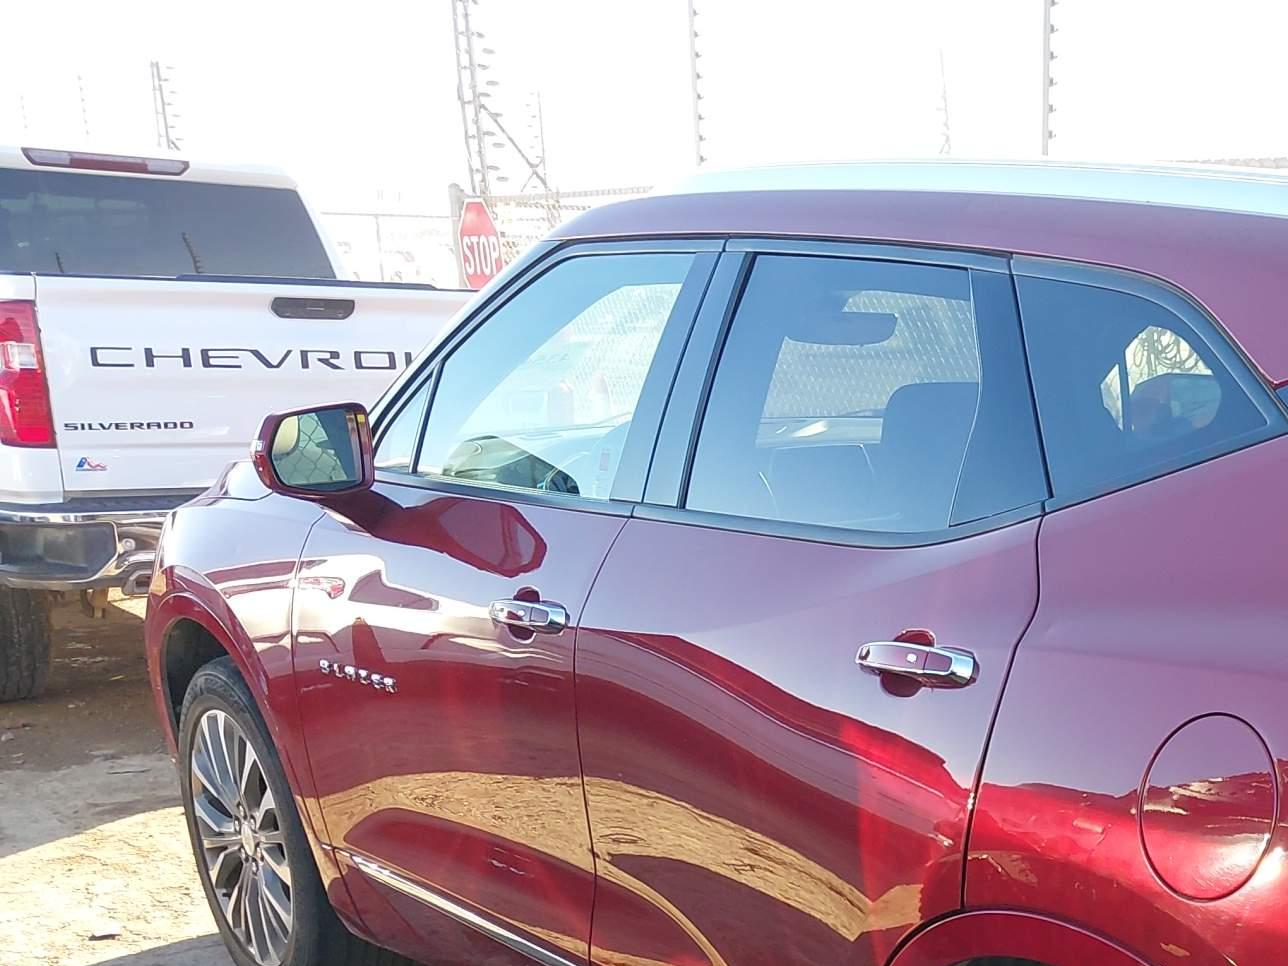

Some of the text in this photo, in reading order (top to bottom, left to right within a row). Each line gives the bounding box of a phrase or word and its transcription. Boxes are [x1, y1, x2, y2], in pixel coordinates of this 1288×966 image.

[462, 235, 500, 275] STOP
[64, 421, 194, 431] SILVERADO
[319, 658, 398, 693] BLAZER
